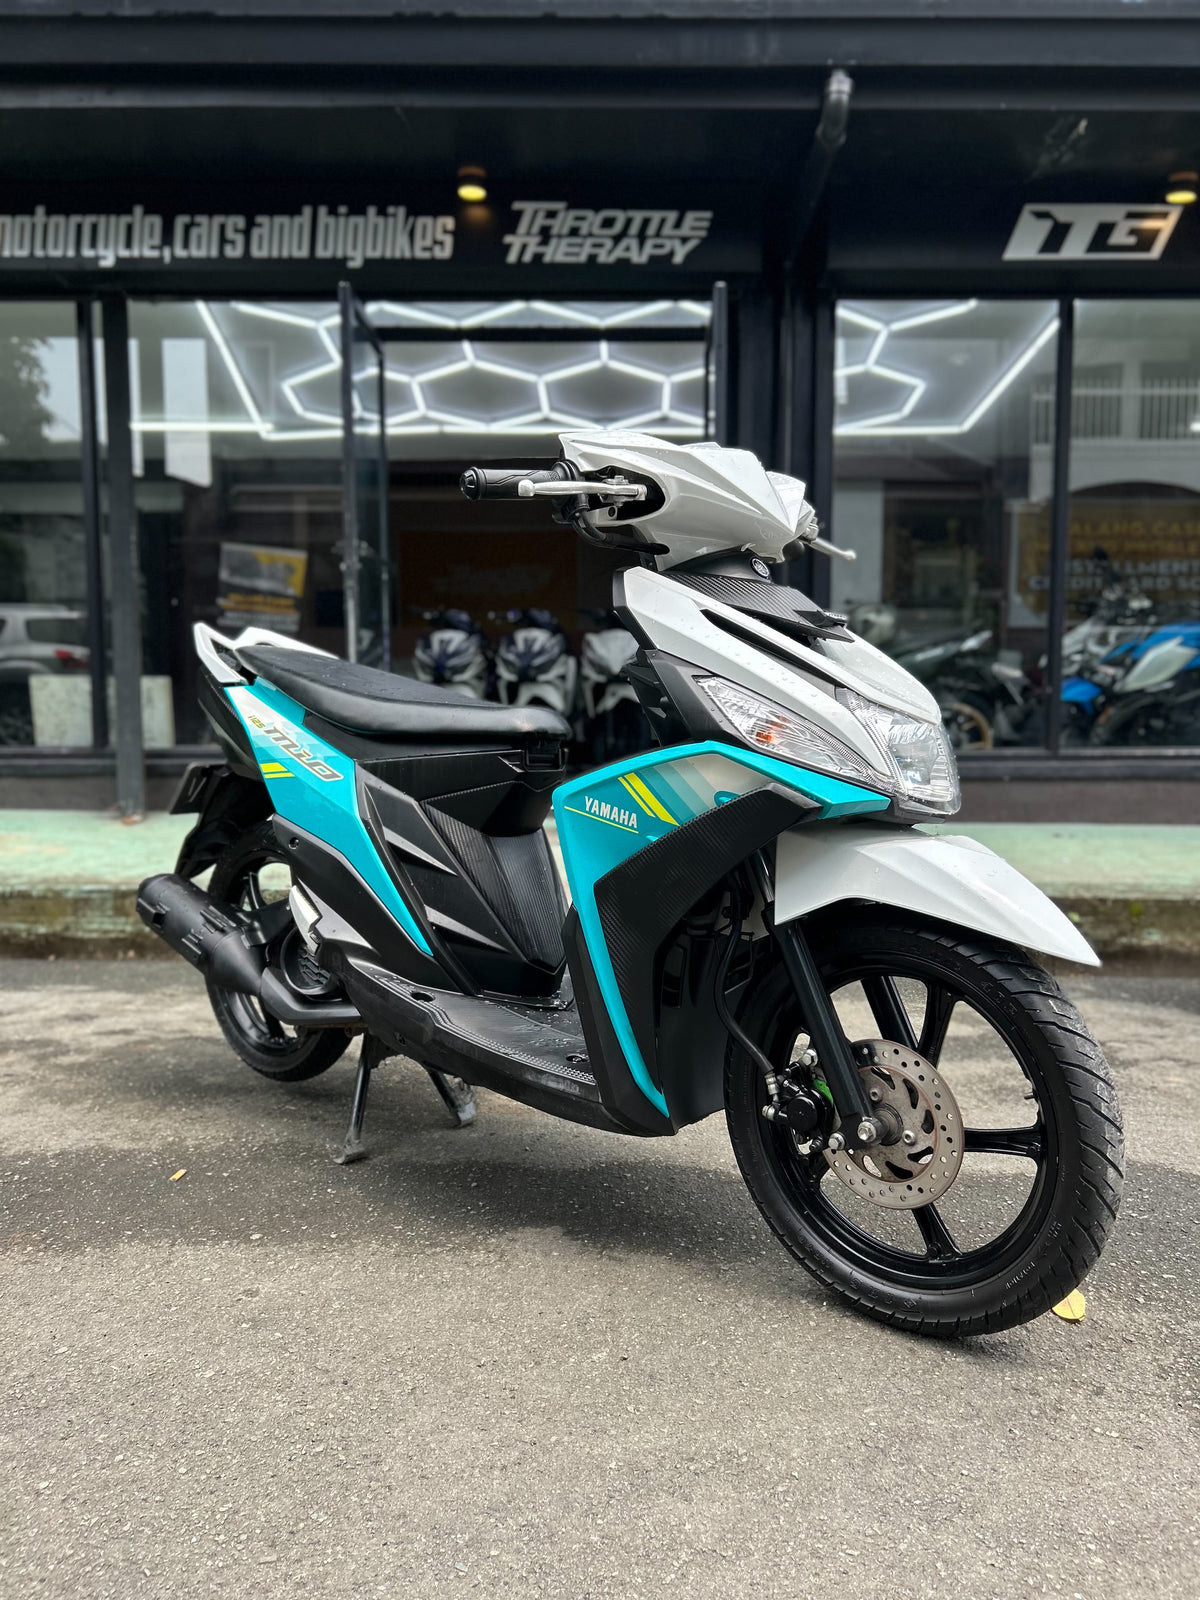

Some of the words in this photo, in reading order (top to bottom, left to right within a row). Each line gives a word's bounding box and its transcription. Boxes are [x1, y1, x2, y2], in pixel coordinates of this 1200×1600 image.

[250, 206, 313, 259] and
[315, 206, 456, 268] bigbikes
[511, 200, 713, 238] THROTTLE
[502, 234, 701, 265] THERAPY
[584, 795, 638, 829] YAMAHA
